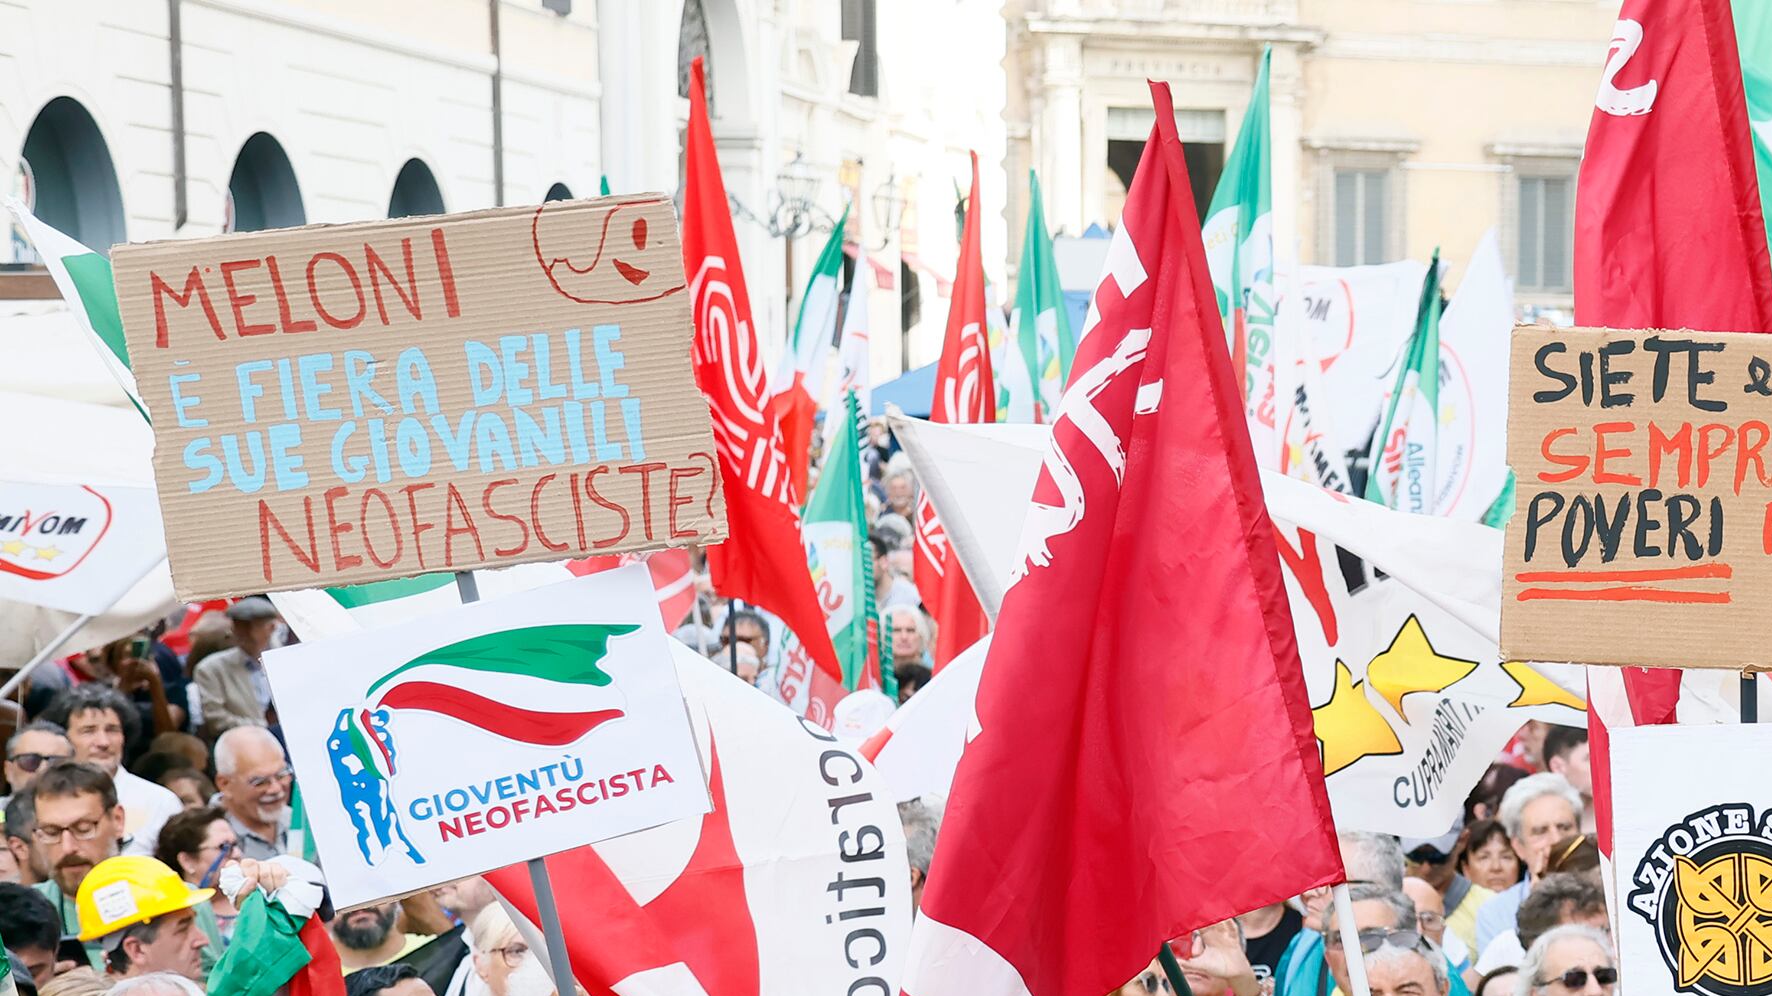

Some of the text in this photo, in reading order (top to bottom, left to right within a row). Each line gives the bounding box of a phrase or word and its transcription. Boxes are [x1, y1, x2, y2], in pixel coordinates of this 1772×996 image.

[150, 227, 462, 349] MELONI
[235, 346, 442, 424] FIERA
[465, 324, 631, 404] DELLE
[1532, 335, 1729, 412] SIETE
[182, 397, 647, 495] SUE GIOVANILI
[1405, 441, 1425, 513] Allean
[257, 450, 723, 584] NEOFASCISTE?
[1523, 488, 1725, 569] POVERI
[409, 754, 585, 822] GIOVENTÙ
[438, 763, 675, 843] NEOFASCISTA
[1632, 807, 1752, 920] AZIONE
